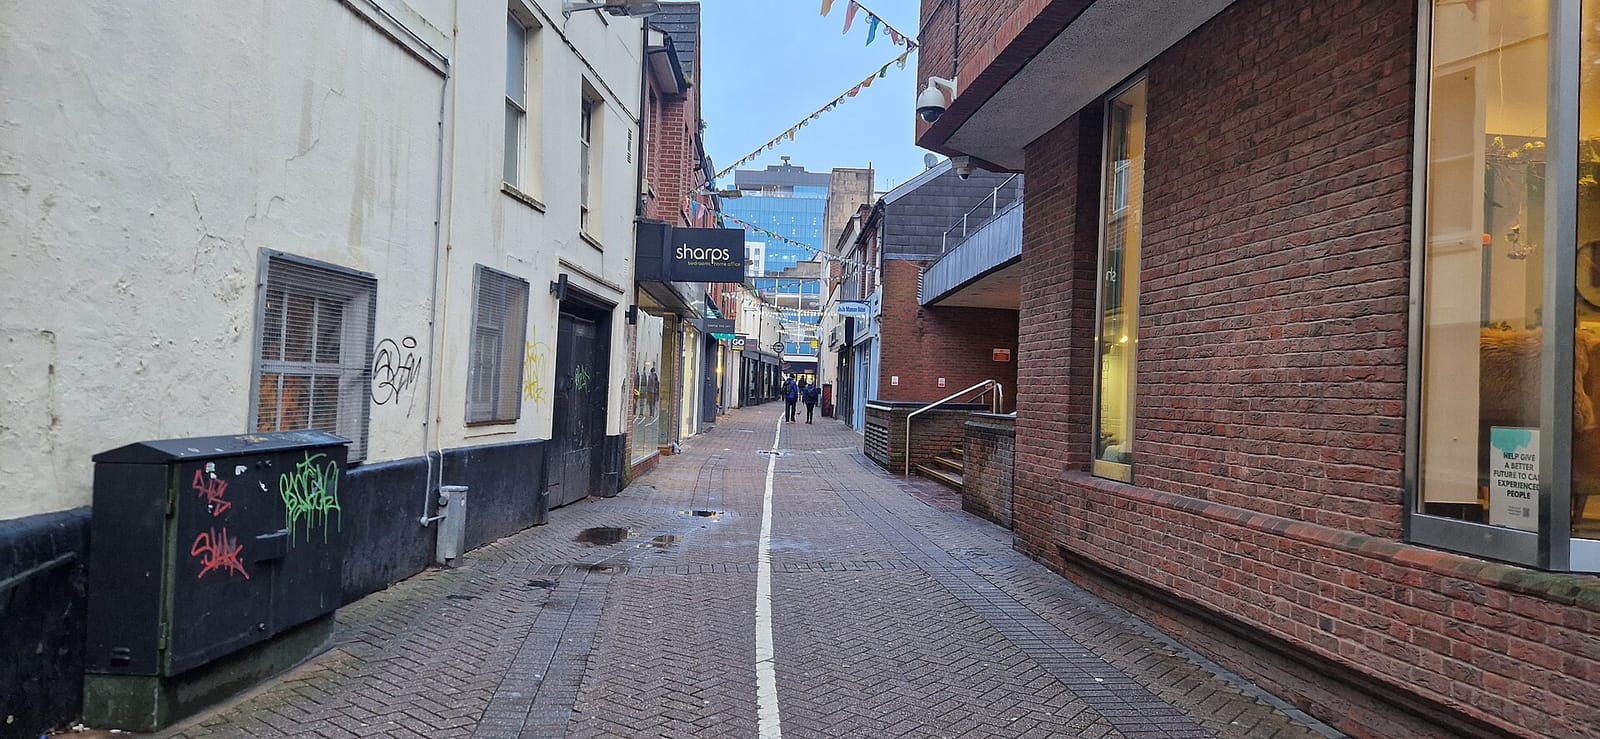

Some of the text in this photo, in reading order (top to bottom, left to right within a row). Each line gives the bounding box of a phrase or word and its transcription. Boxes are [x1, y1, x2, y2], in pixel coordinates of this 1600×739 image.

[675, 243, 730, 265] sharps
[732, 338, 745, 346] GO
[1504, 452, 1519, 460] HELP
[1511, 463, 1534, 471] BETTER
[1493, 470, 1516, 479] FUTURE
[1507, 490, 1531, 499] PEOPLE
